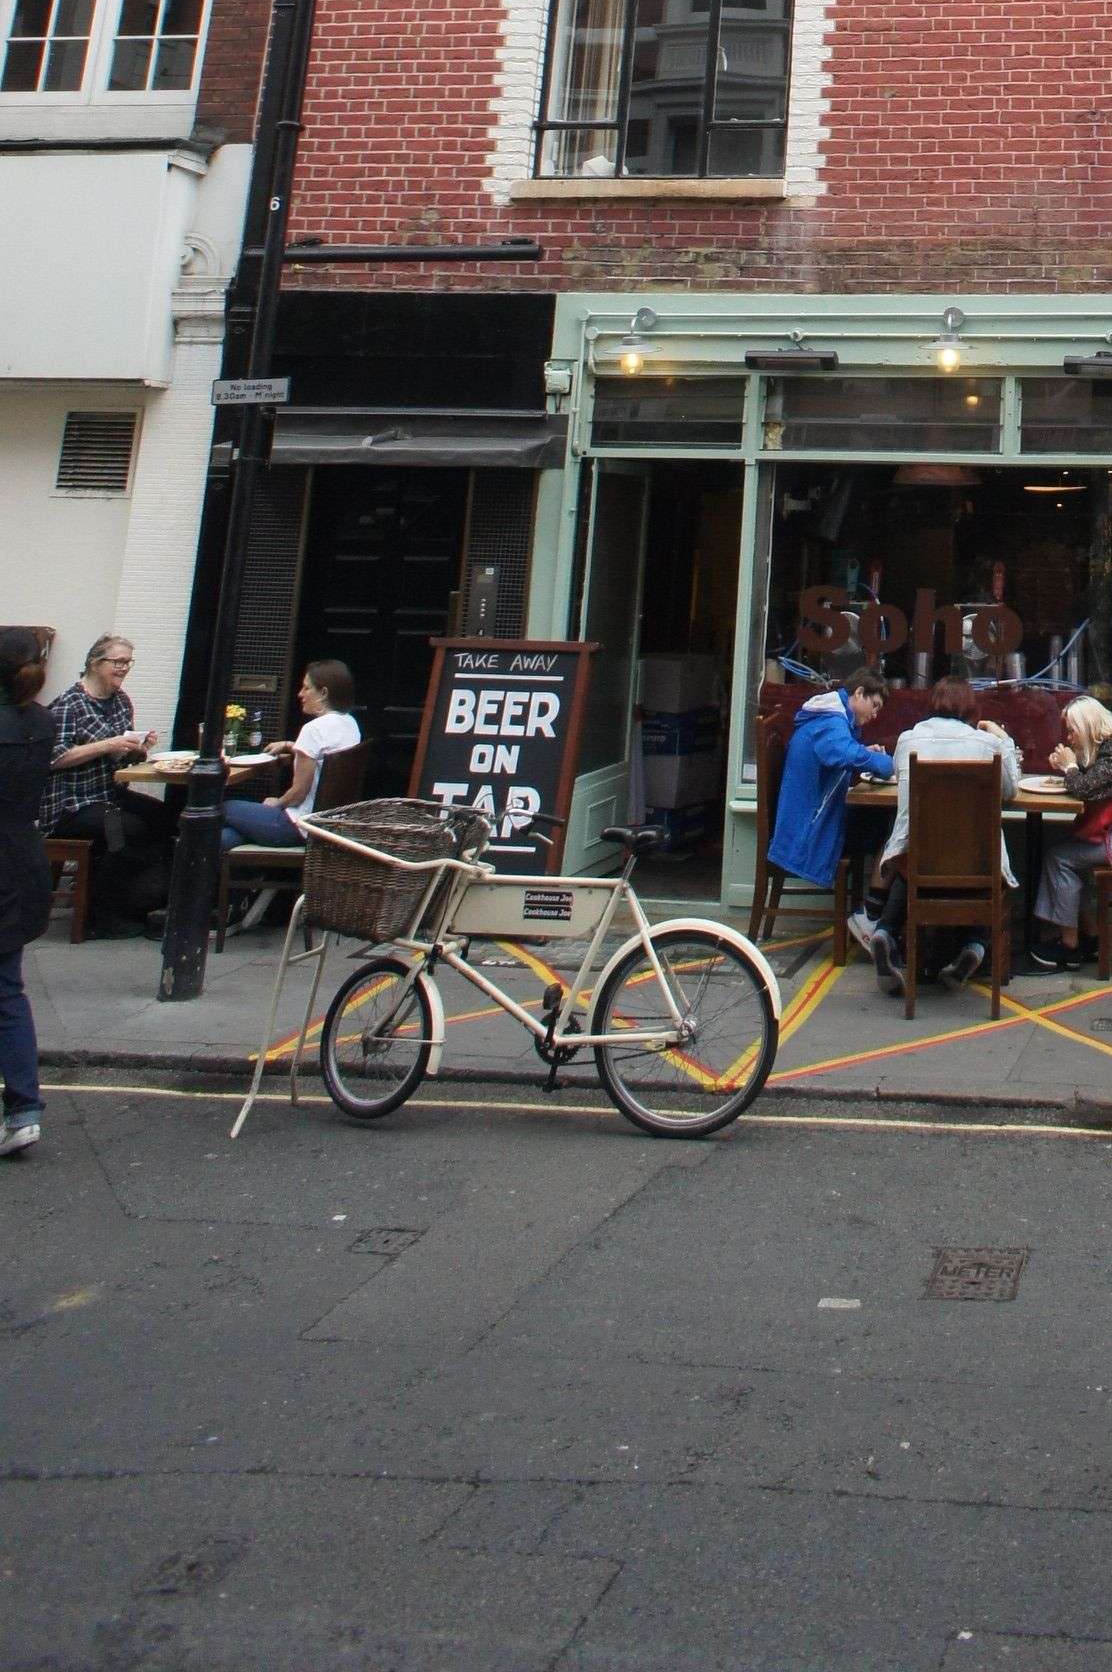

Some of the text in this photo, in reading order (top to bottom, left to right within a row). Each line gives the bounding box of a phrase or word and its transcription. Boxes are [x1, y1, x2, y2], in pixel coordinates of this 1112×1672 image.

[271, 197, 280, 211] 6
[244, 383, 273, 392] loading
[797, 584, 1024, 656] Soho
[454, 653, 560, 672] TAKE AWAY
[445, 689, 561, 738] BEER
[468, 744, 521, 774] ON
[432, 782, 542, 839] TAP
[526, 893, 573, 902] Cookhouse Joe
[524, 908, 571, 916] Cookhouse Joe
